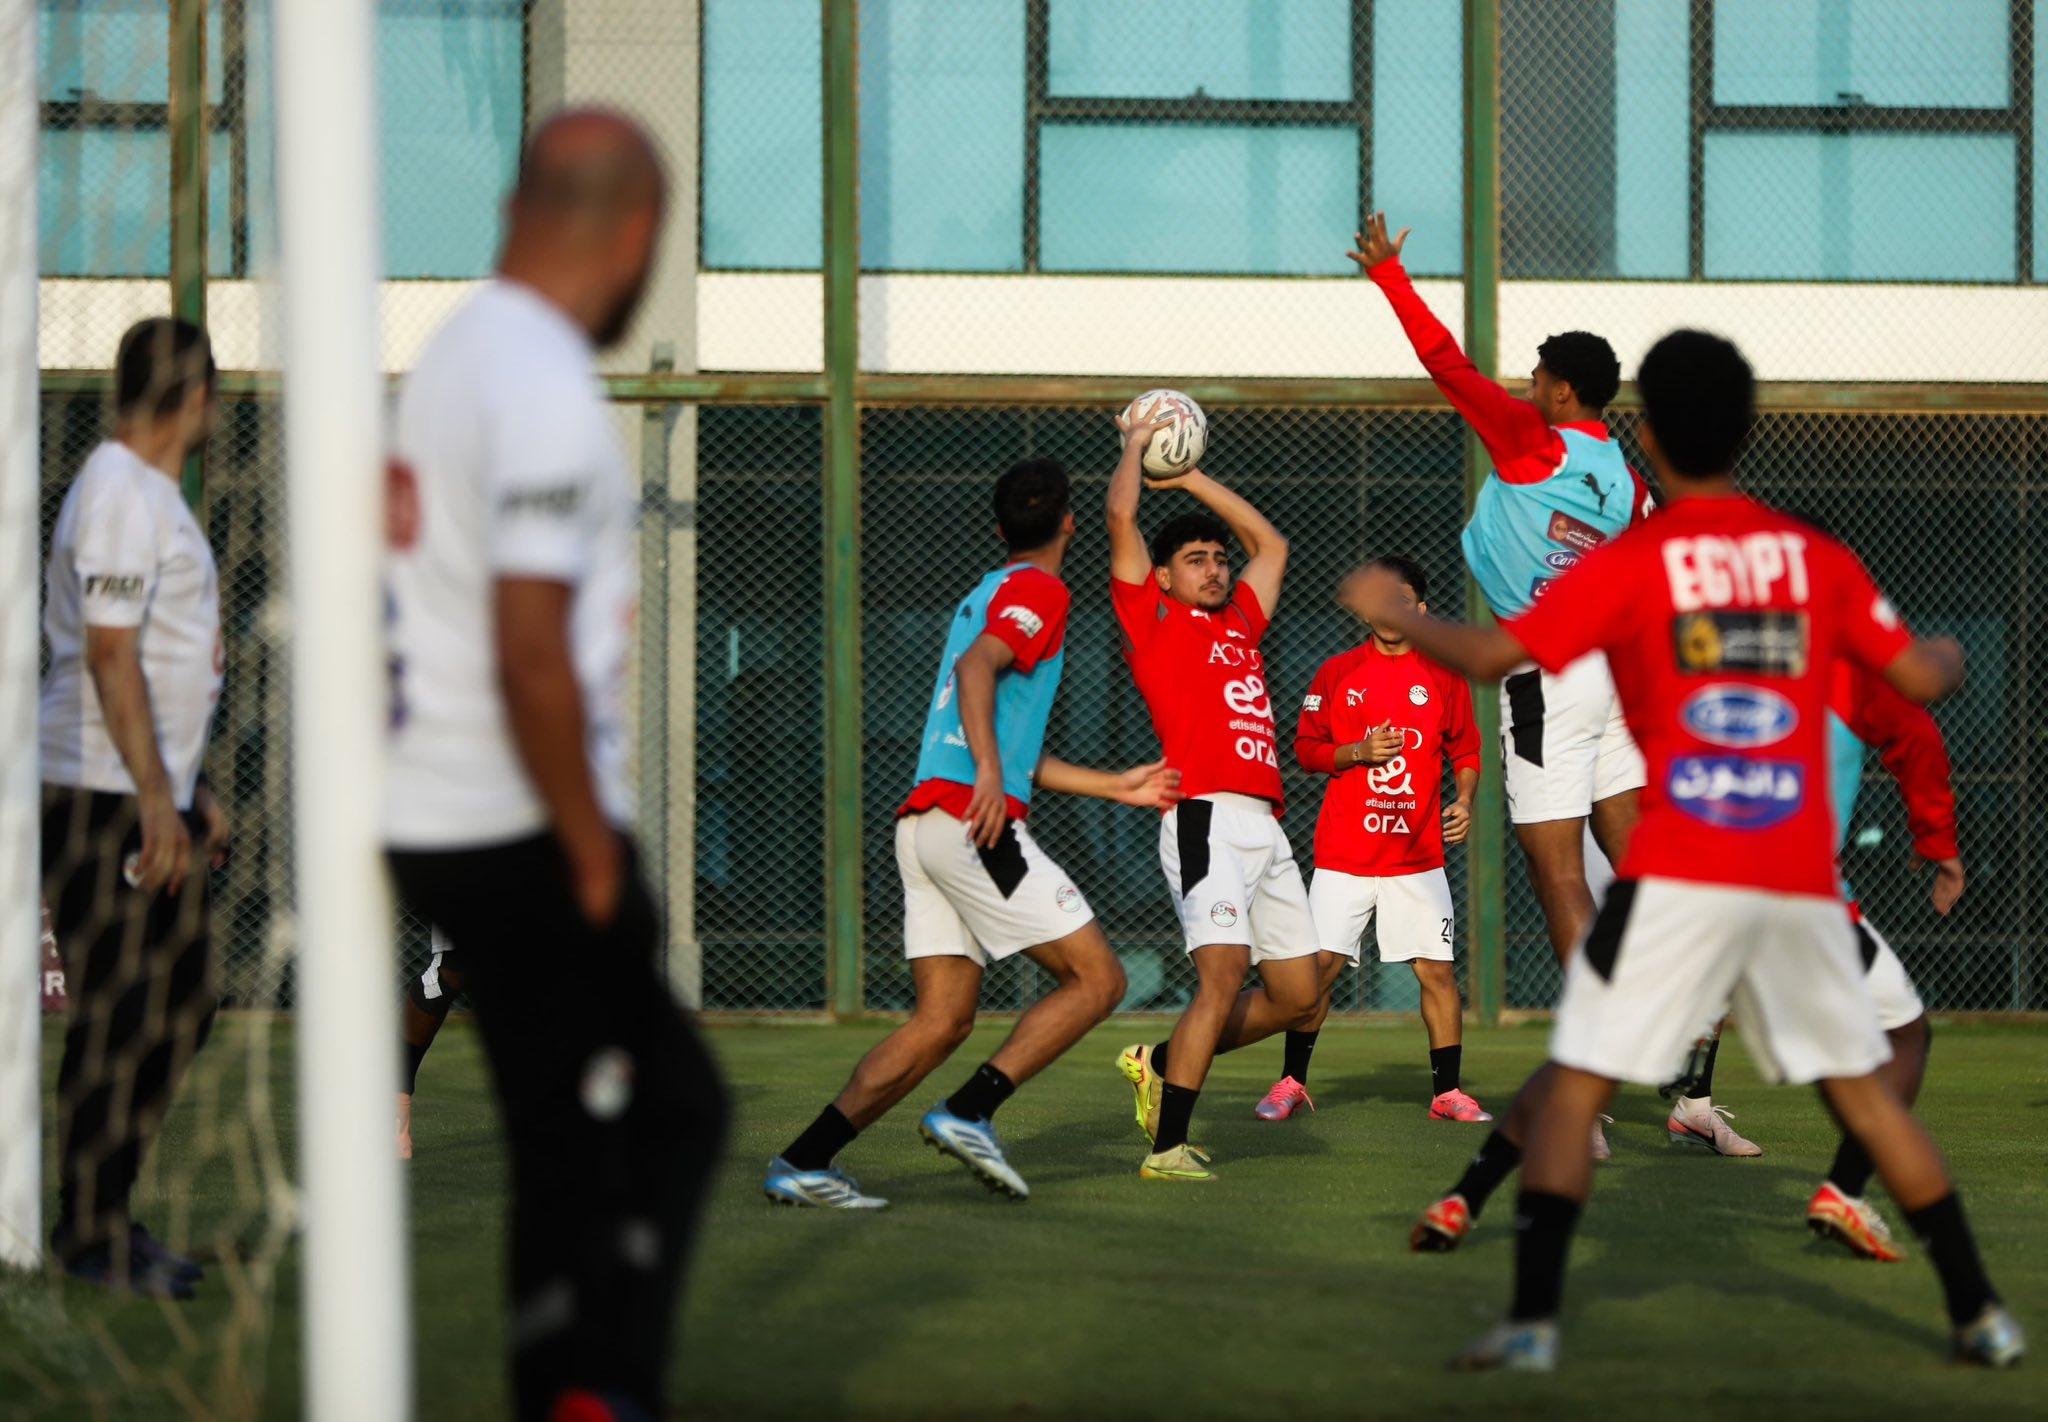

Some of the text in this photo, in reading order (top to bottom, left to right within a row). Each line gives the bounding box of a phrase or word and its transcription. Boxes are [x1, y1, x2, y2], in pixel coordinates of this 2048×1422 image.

[1662, 531, 1809, 612] EGYPT
[1346, 696, 1356, 707] 14
[1229, 718, 1265, 734] etisalat
[1397, 800, 1416, 810] and
[44, 970, 66, 996] R
